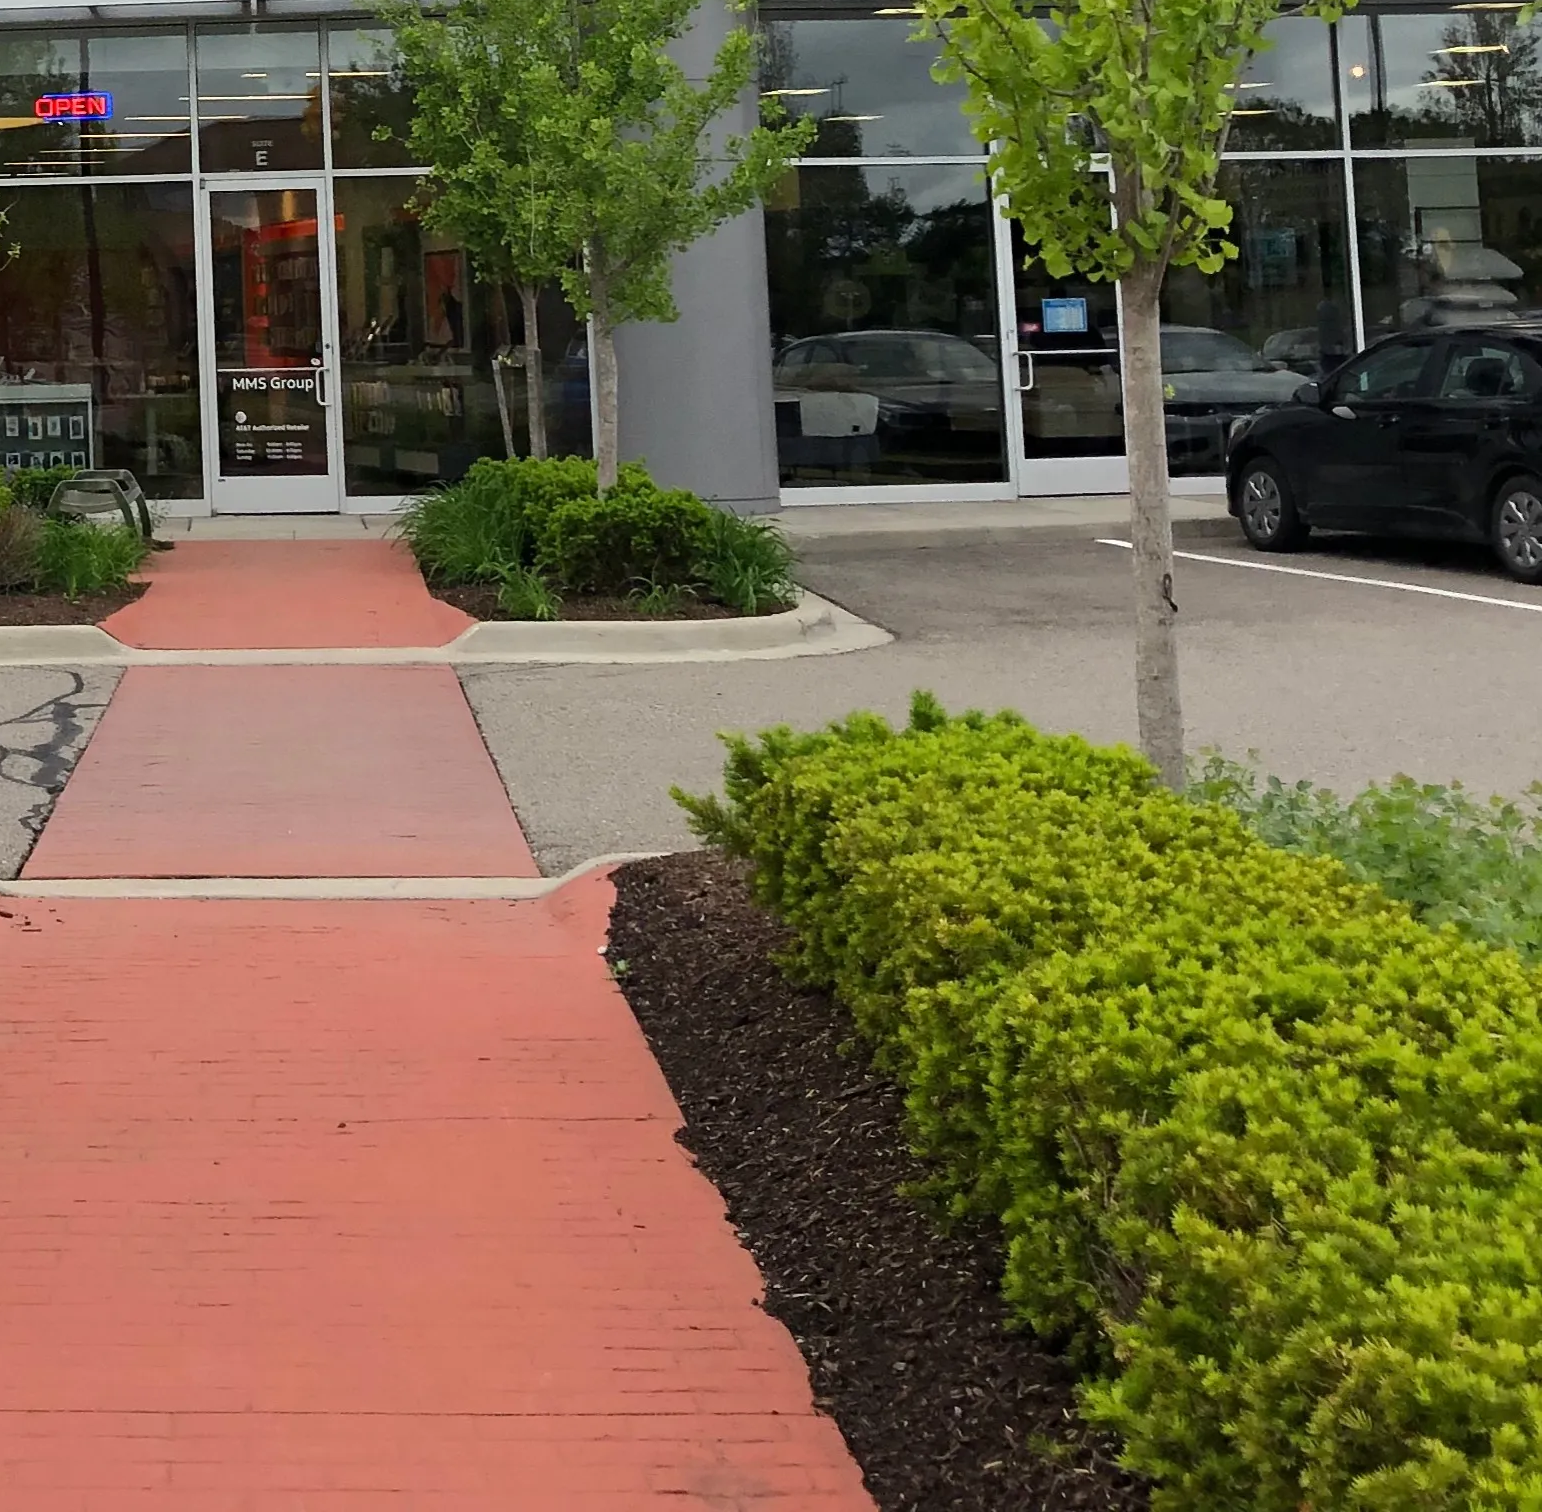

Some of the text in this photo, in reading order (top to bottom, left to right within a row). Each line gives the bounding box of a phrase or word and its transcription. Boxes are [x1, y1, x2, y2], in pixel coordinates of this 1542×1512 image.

[35, 97, 106, 117] OPEN
[255, 150, 269, 166] E
[232, 376, 314, 392] MMS Group
